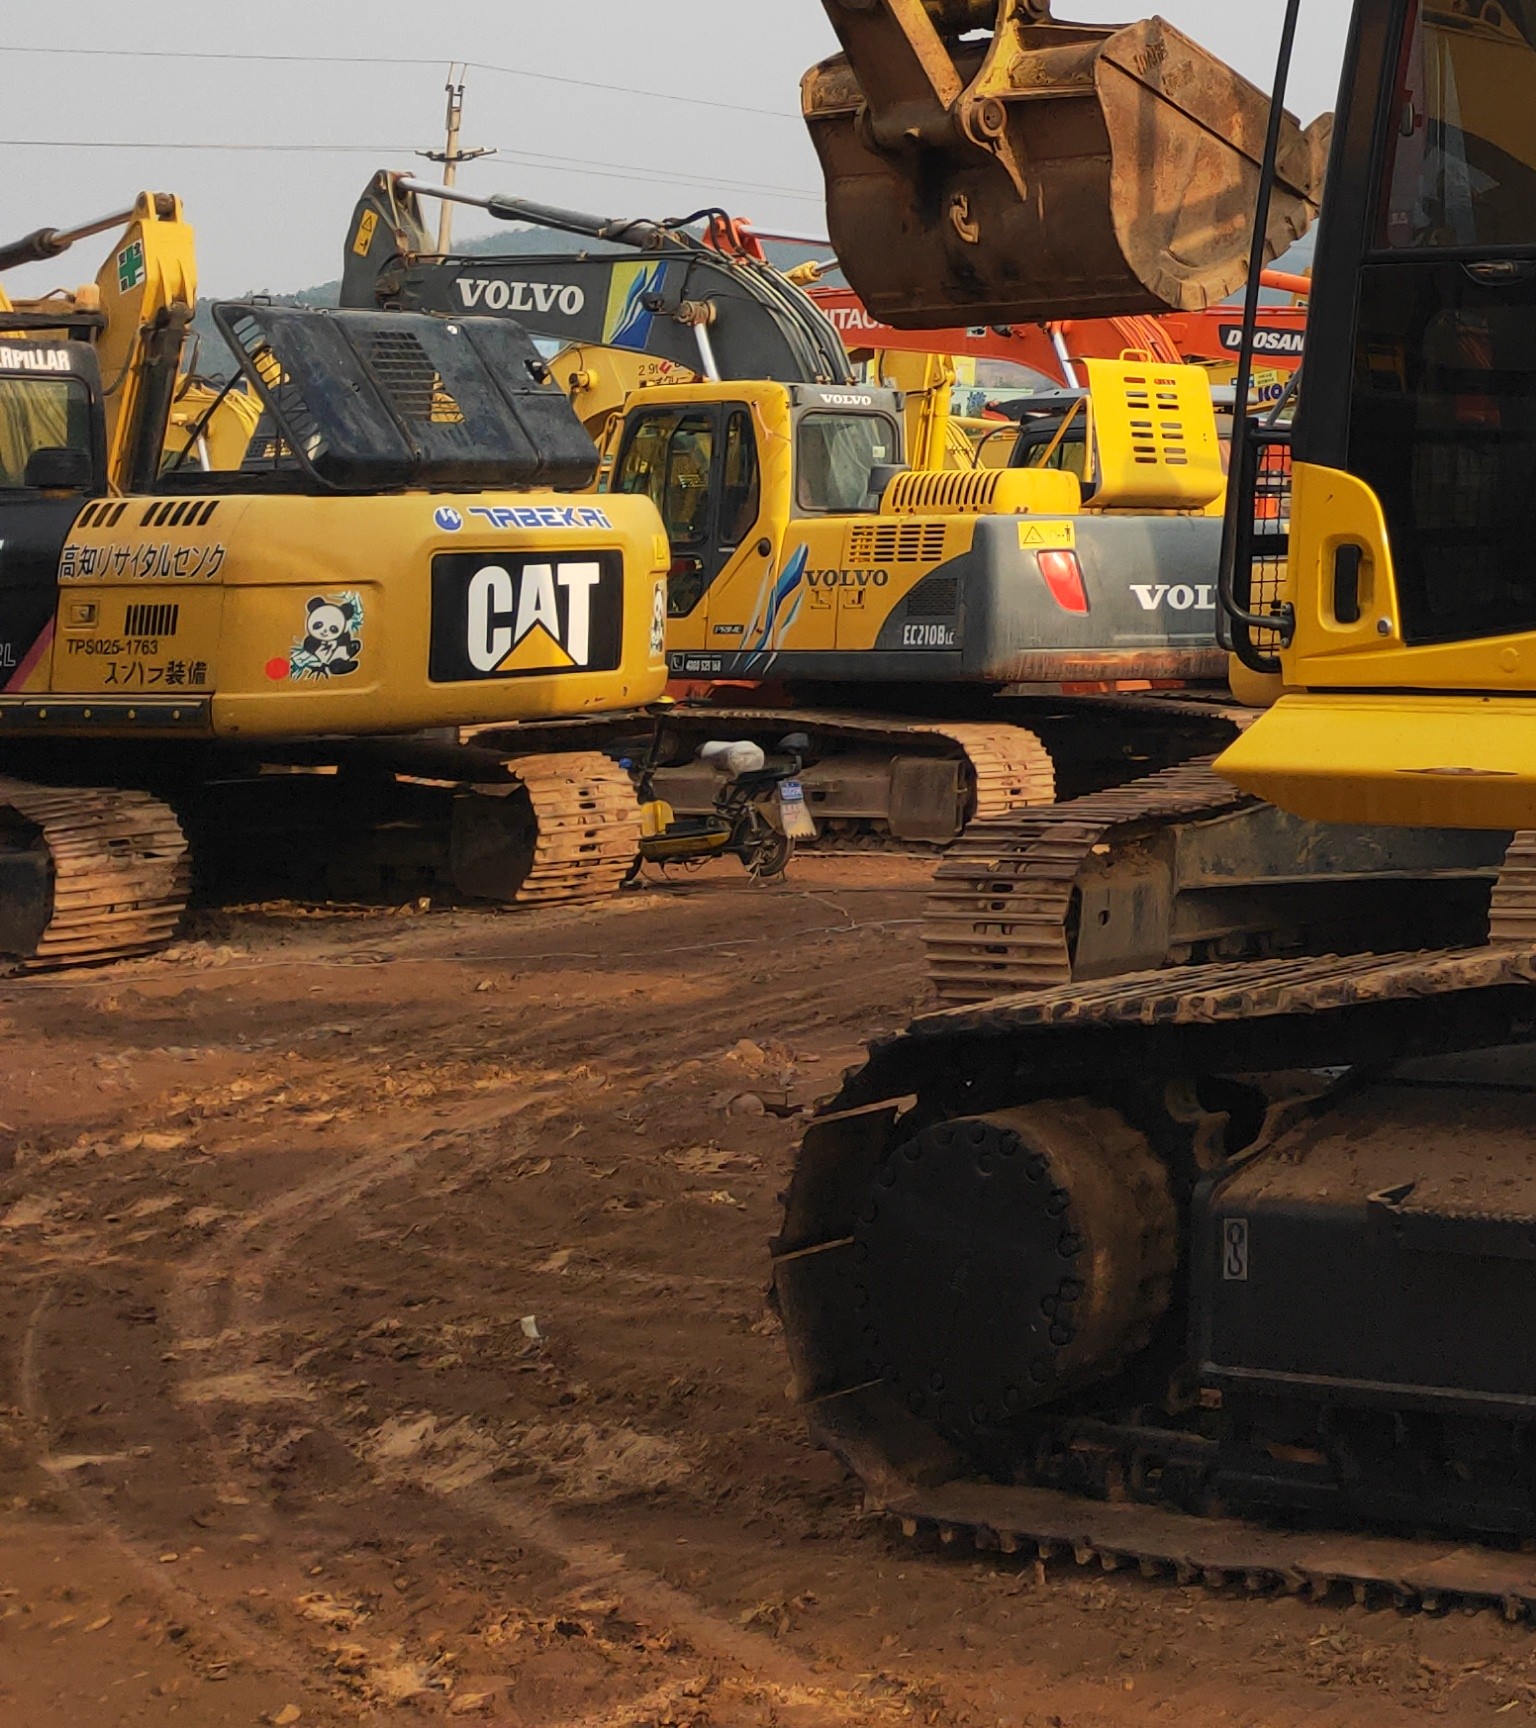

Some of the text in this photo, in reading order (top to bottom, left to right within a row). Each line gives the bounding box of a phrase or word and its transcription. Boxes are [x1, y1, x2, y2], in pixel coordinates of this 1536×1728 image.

[456, 278, 585, 315] VOLVO
[824, 308, 894, 330] ITAC
[1226, 329, 1304, 351] DOSAN
[0, 346, 71, 371] RPILLAR
[819, 393, 872, 405] VOLVO
[805, 569, 889, 587] VOLVO
[1129, 584, 1219, 610] VOL
[467, 562, 600, 672] CAT
[67, 639, 158, 655] TPS025-1763
